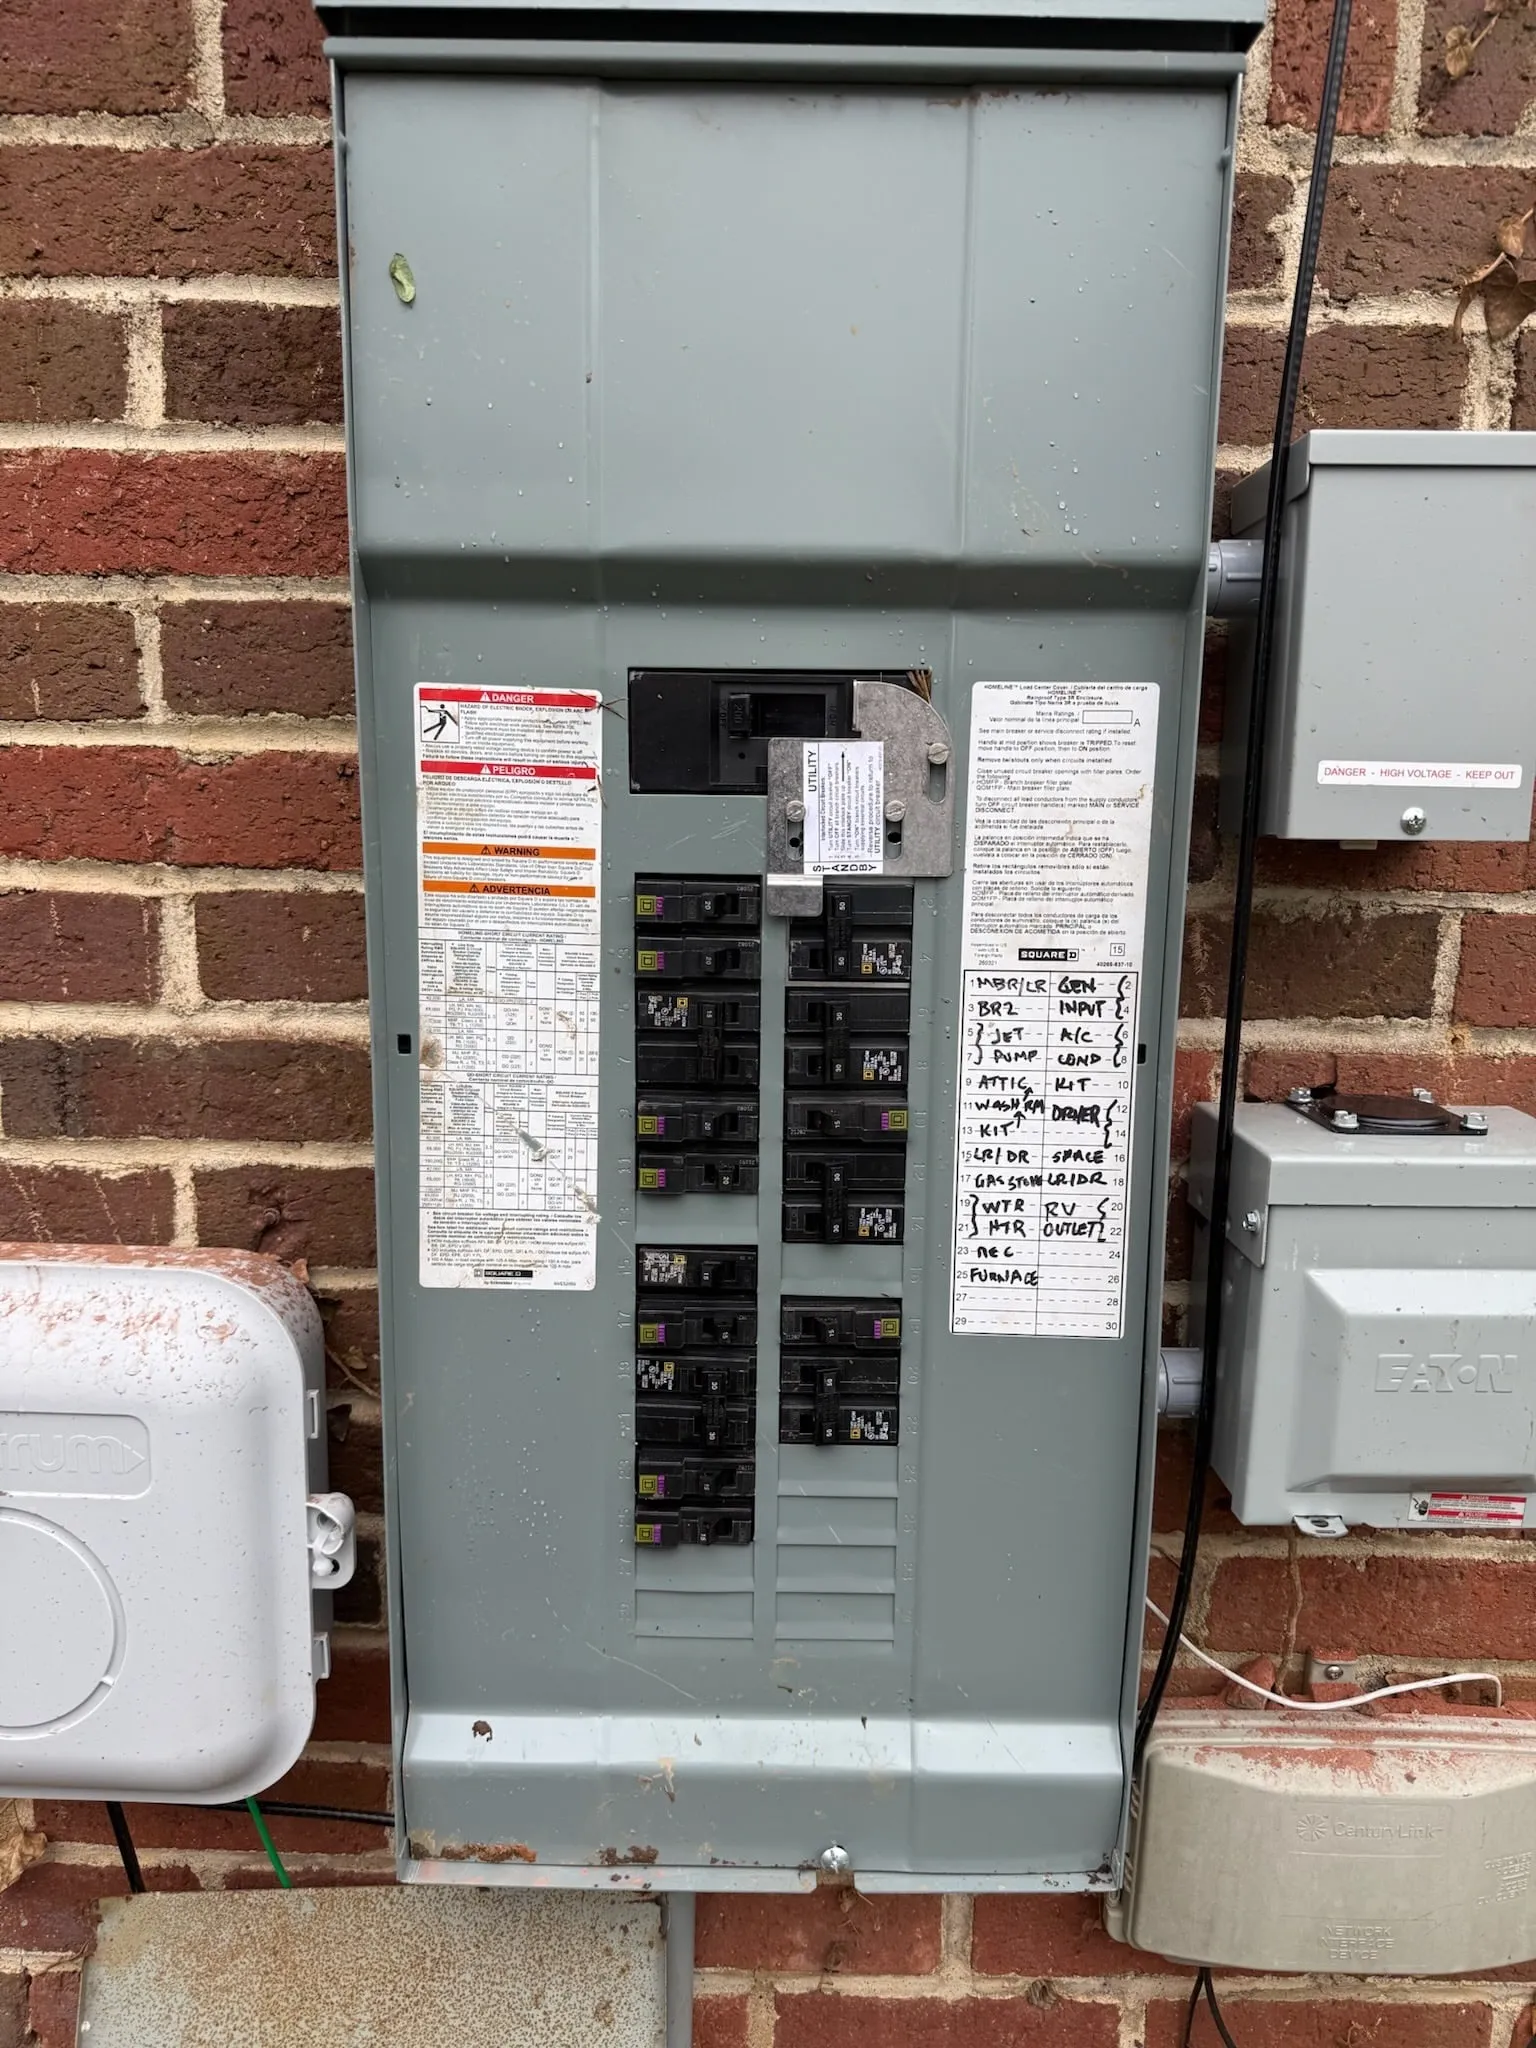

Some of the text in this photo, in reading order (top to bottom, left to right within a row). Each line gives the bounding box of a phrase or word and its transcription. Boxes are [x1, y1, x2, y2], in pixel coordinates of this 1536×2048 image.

[492, 693, 535, 702] DANGER
[1134, 719, 1140, 727] A
[492, 767, 536, 775] PELIGRO
[808, 750, 817, 792] UTILITY
[1324, 768, 1366, 776] DANGER
[1380, 768, 1404, 777] HIGH
[1408, 769, 1451, 779] VOLTAGE
[1466, 770, 1492, 779] KEEP
[1494, 771, 1515, 780] OUT
[494, 847, 540, 856] WARNING
[813, 864, 877, 872] STANDBY
[483, 885, 550, 895] ADVERTENCIA
[704, 900, 712, 910] 20
[839, 901, 846, 911] 50
[1113, 946, 1123, 954] 15
[1021, 951, 1065, 959] SQUARE
[838, 956, 845, 966] 50
[971, 979, 974, 987] 1
[1058, 976, 1096, 993] GEN
[978, 1001, 1018, 1017] BR2
[1059, 1000, 1106, 1017] INPUT
[1124, 1006, 1129, 1014] 4
[836, 1012, 843, 1021] 30
[967, 1028, 973, 1036] 5
[991, 1027, 1024, 1044] JET
[1060, 1027, 1093, 1044] A/C
[1122, 1031, 1129, 1039] 6
[994, 1050, 1038, 1063] PUMP
[1058, 1054, 1102, 1066] COND
[1121, 1056, 1127, 1064] 8
[835, 1063, 842, 1073] 30
[978, 1075, 1028, 1091] ATTIC
[1055, 1077, 1091, 1092] KIT
[1118, 1081, 1129, 1089] 10
[704, 1121, 711, 1131] 20
[980, 1121, 1014, 1138] KIT
[1115, 1154, 1125, 1162] 16
[722, 1176, 730, 1185] 20
[834, 1173, 841, 1182] 30
[975, 1174, 1005, 1188] GAS
[1113, 1178, 1124, 1186] 18
[982, 1199, 1024, 1214] WTR
[1111, 1203, 1123, 1211] 20
[1044, 1202, 1076, 1221] RV
[833, 1224, 840, 1233] 30
[989, 1220, 1026, 1238] HTR
[1044, 1222, 1100, 1238] OUTLET
[1109, 1251, 1120, 1259] 24
[970, 1268, 1039, 1286] FURNACE
[1108, 1275, 1119, 1283] 26
[1106, 1298, 1119, 1306] 28
[1106, 1322, 1117, 1330] 30
[1375, 1353, 1518, 1393] EATON
[711, 1381, 718, 1390] 30
